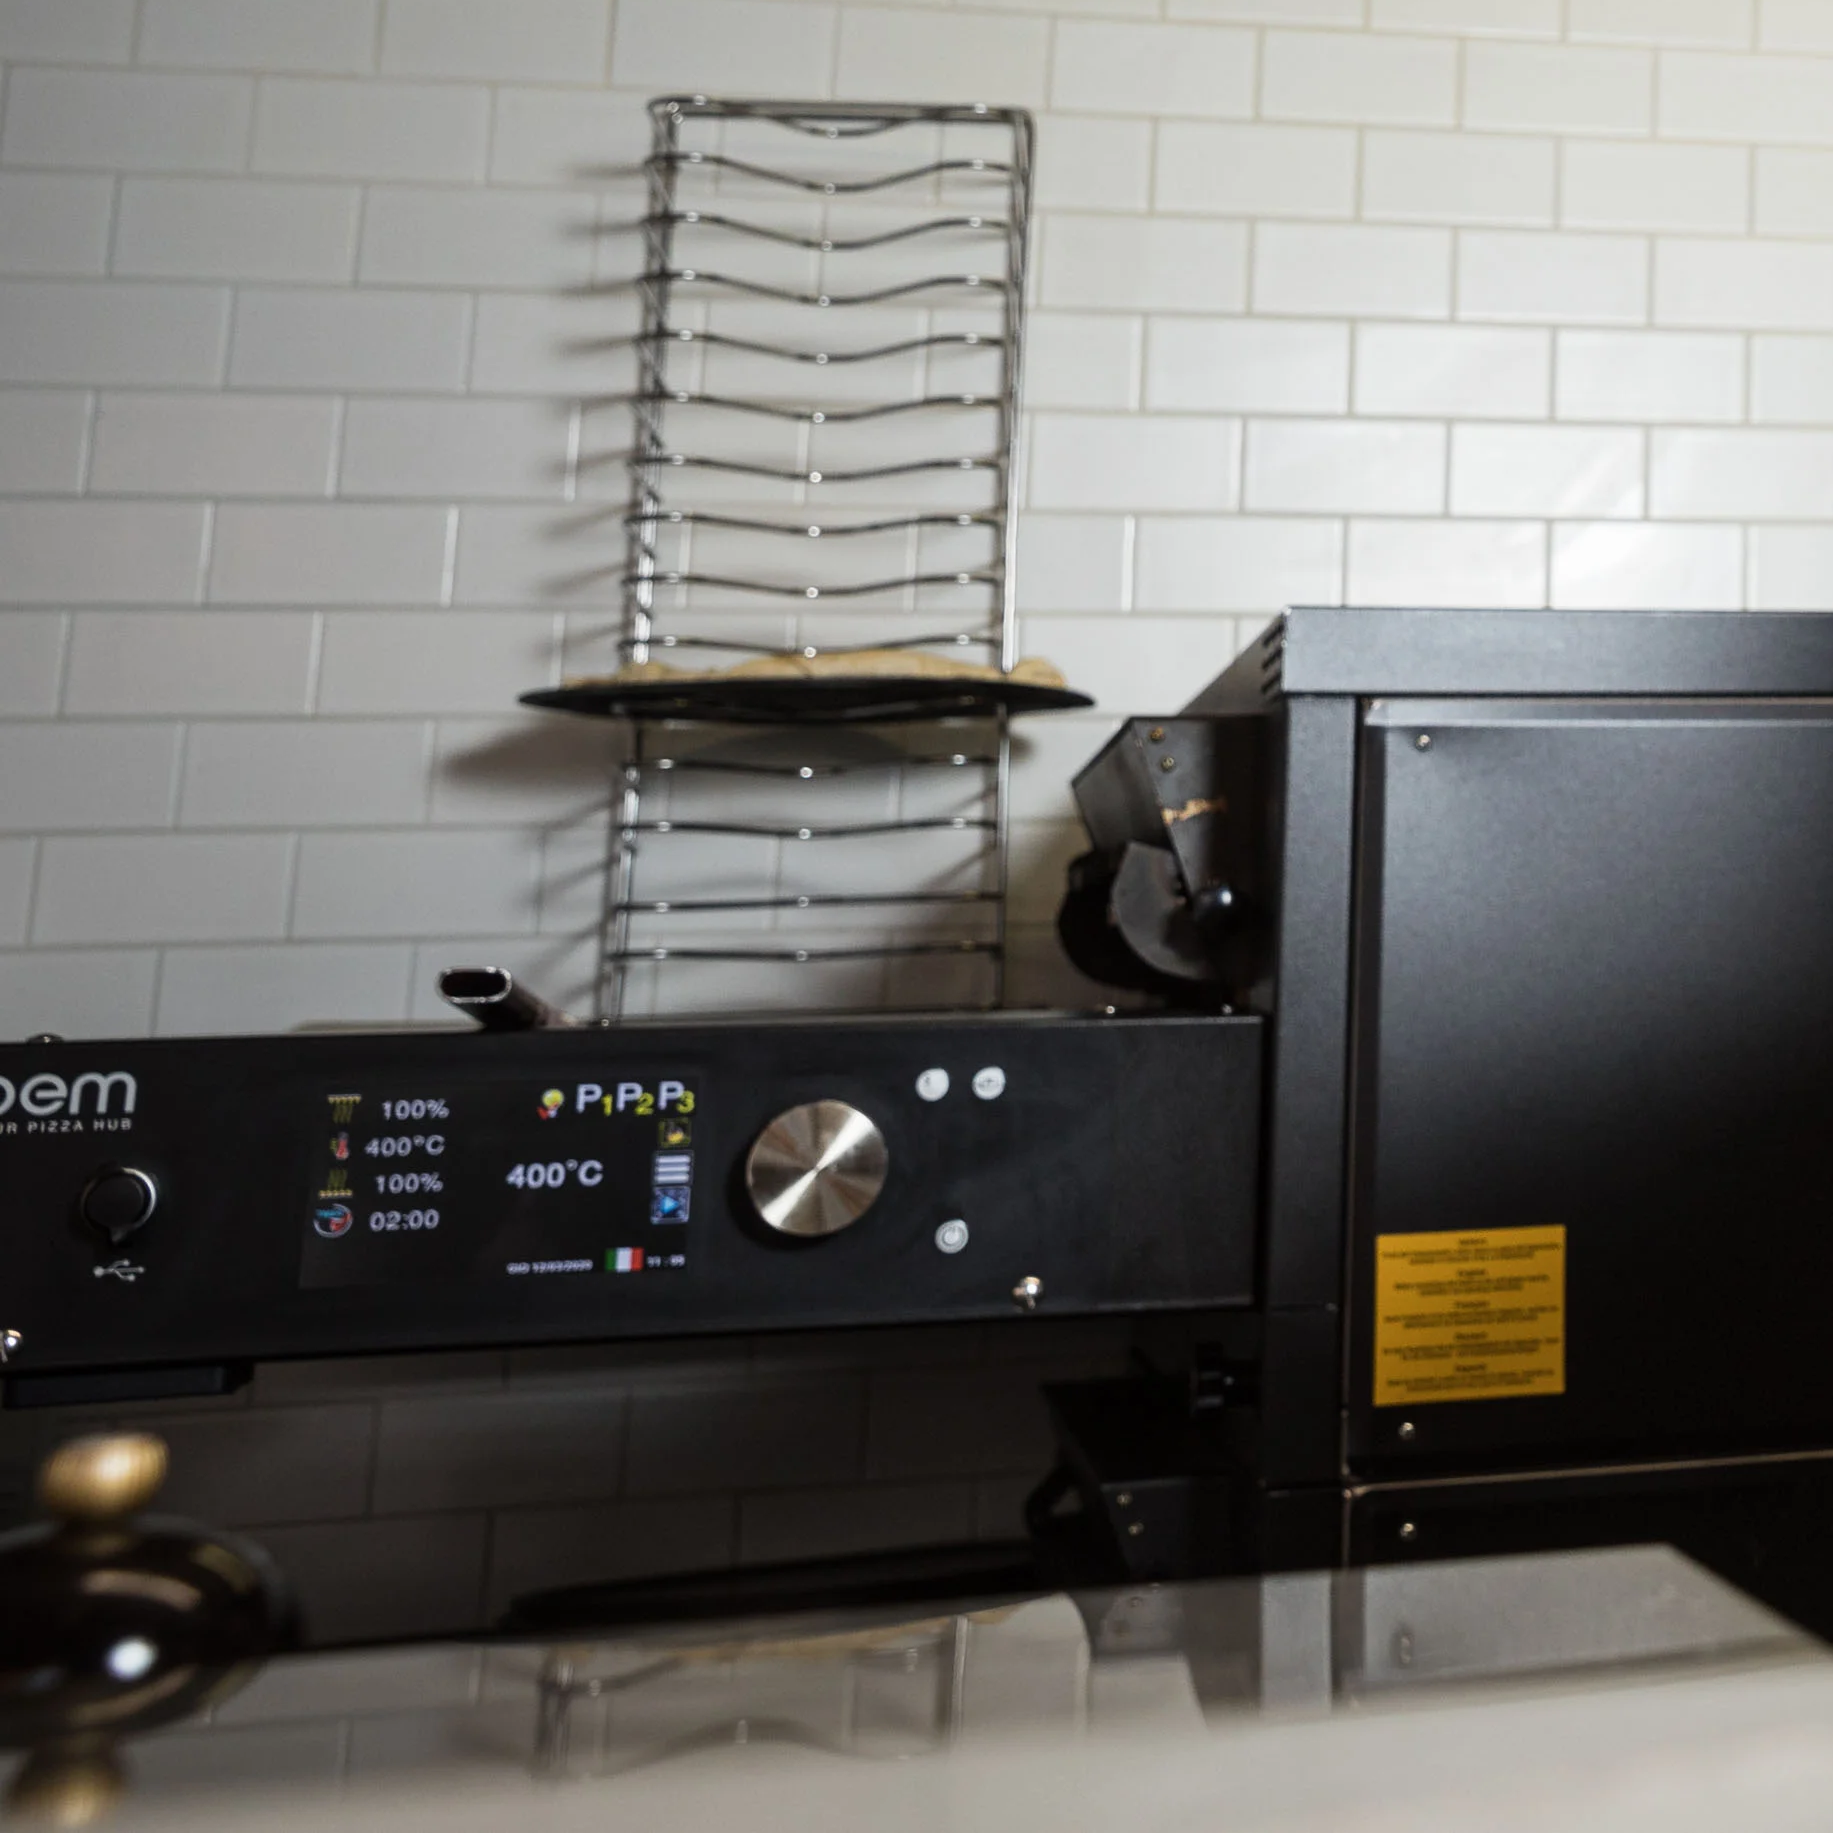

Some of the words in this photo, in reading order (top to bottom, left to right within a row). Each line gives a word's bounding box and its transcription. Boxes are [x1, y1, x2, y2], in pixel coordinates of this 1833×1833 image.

[382, 1098, 449, 1120] 100%
[28, 1119, 83, 1134] PIZZA
[93, 1117, 132, 1132] HUB
[364, 1134, 446, 1158] 400°C
[375, 1171, 444, 1194] 100%
[506, 1159, 603, 1189] 400°C
[369, 1209, 440, 1232] 02:00
